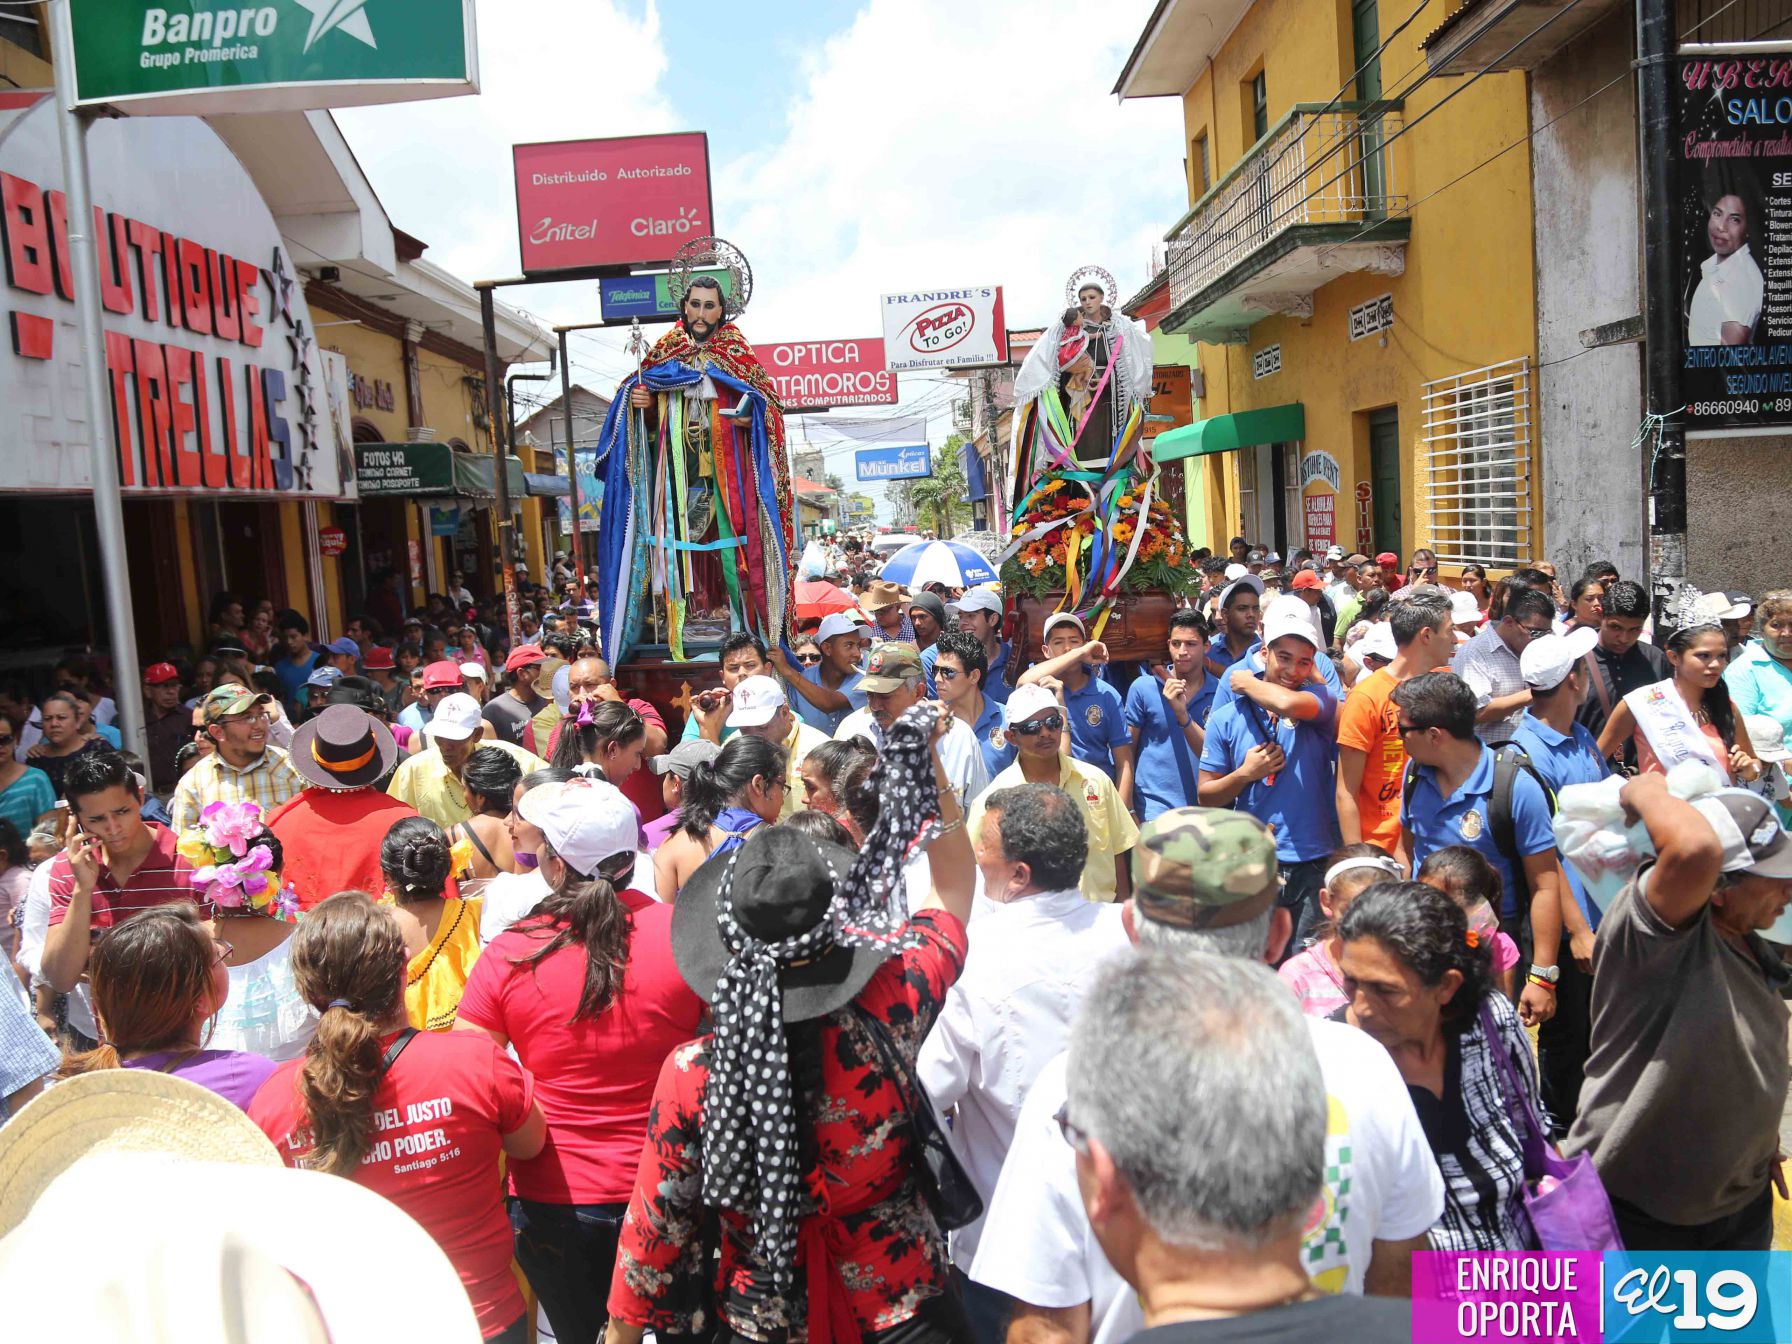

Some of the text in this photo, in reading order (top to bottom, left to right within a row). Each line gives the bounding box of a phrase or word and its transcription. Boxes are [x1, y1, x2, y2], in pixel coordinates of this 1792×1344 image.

[141, 7, 278, 48] Banpro
[140, 43, 259, 69] Grupo Promerica
[532, 163, 692, 186] Distribuido Autorizado
[630, 215, 692, 237] Claro
[773, 342, 860, 367] OPTICA
[890, 361, 908, 370] Para
[909, 358, 944, 367] Disfrutar
[957, 354, 985, 364] Familia
[801, 393, 892, 407] COMPUTARIZADOS
[1694, 400, 1759, 416] 86660940
[363, 450, 406, 468] FOTOS YA
[858, 457, 927, 477] Münkel
[374, 1096, 453, 1132] DEL JUSTO
[395, 1128, 451, 1158] PODER.
[394, 1147, 461, 1175] Santiago 5:16
